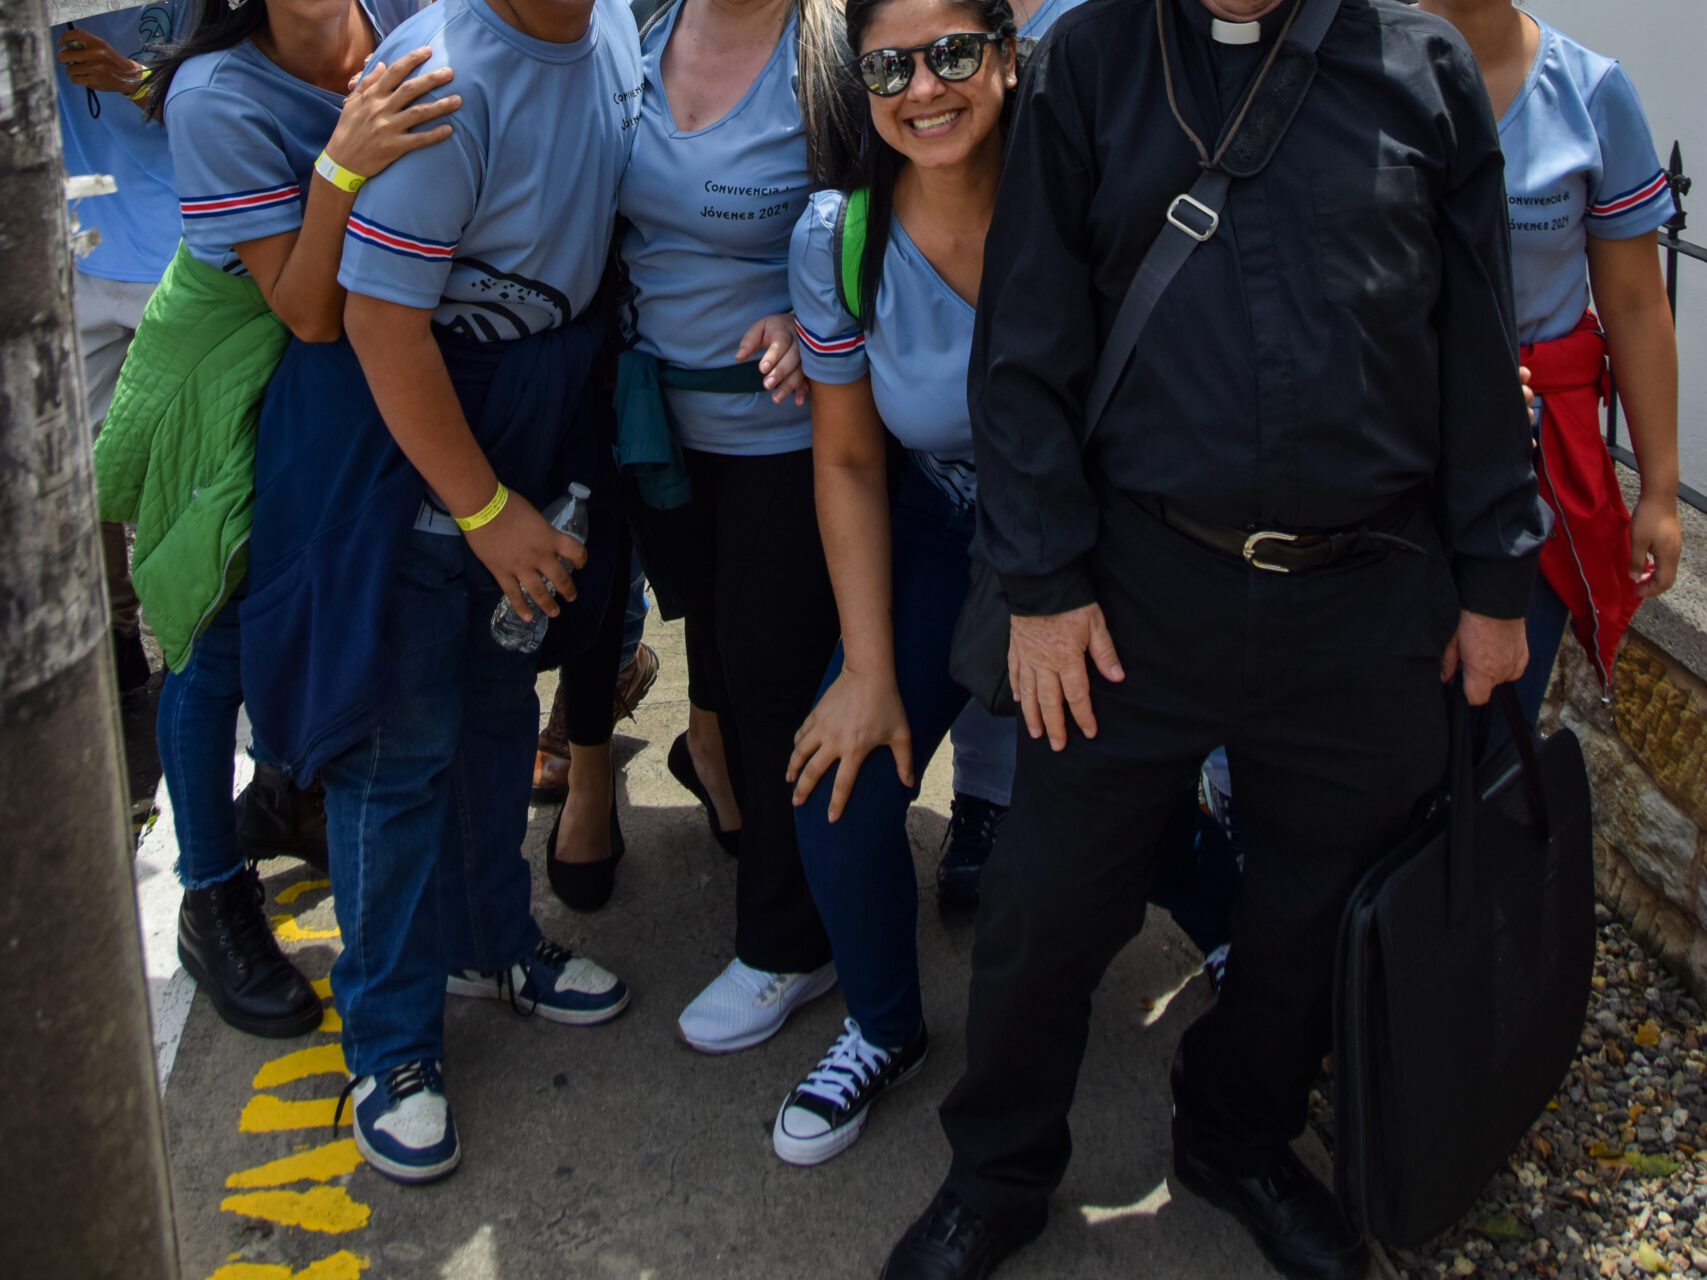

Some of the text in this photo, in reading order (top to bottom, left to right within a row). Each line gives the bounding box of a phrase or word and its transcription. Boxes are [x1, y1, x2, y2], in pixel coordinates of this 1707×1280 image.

[1507, 193, 1562, 206] onvivencia
[758, 201, 789, 220] 2024
[1508, 215, 1569, 231] óvenes 2024
